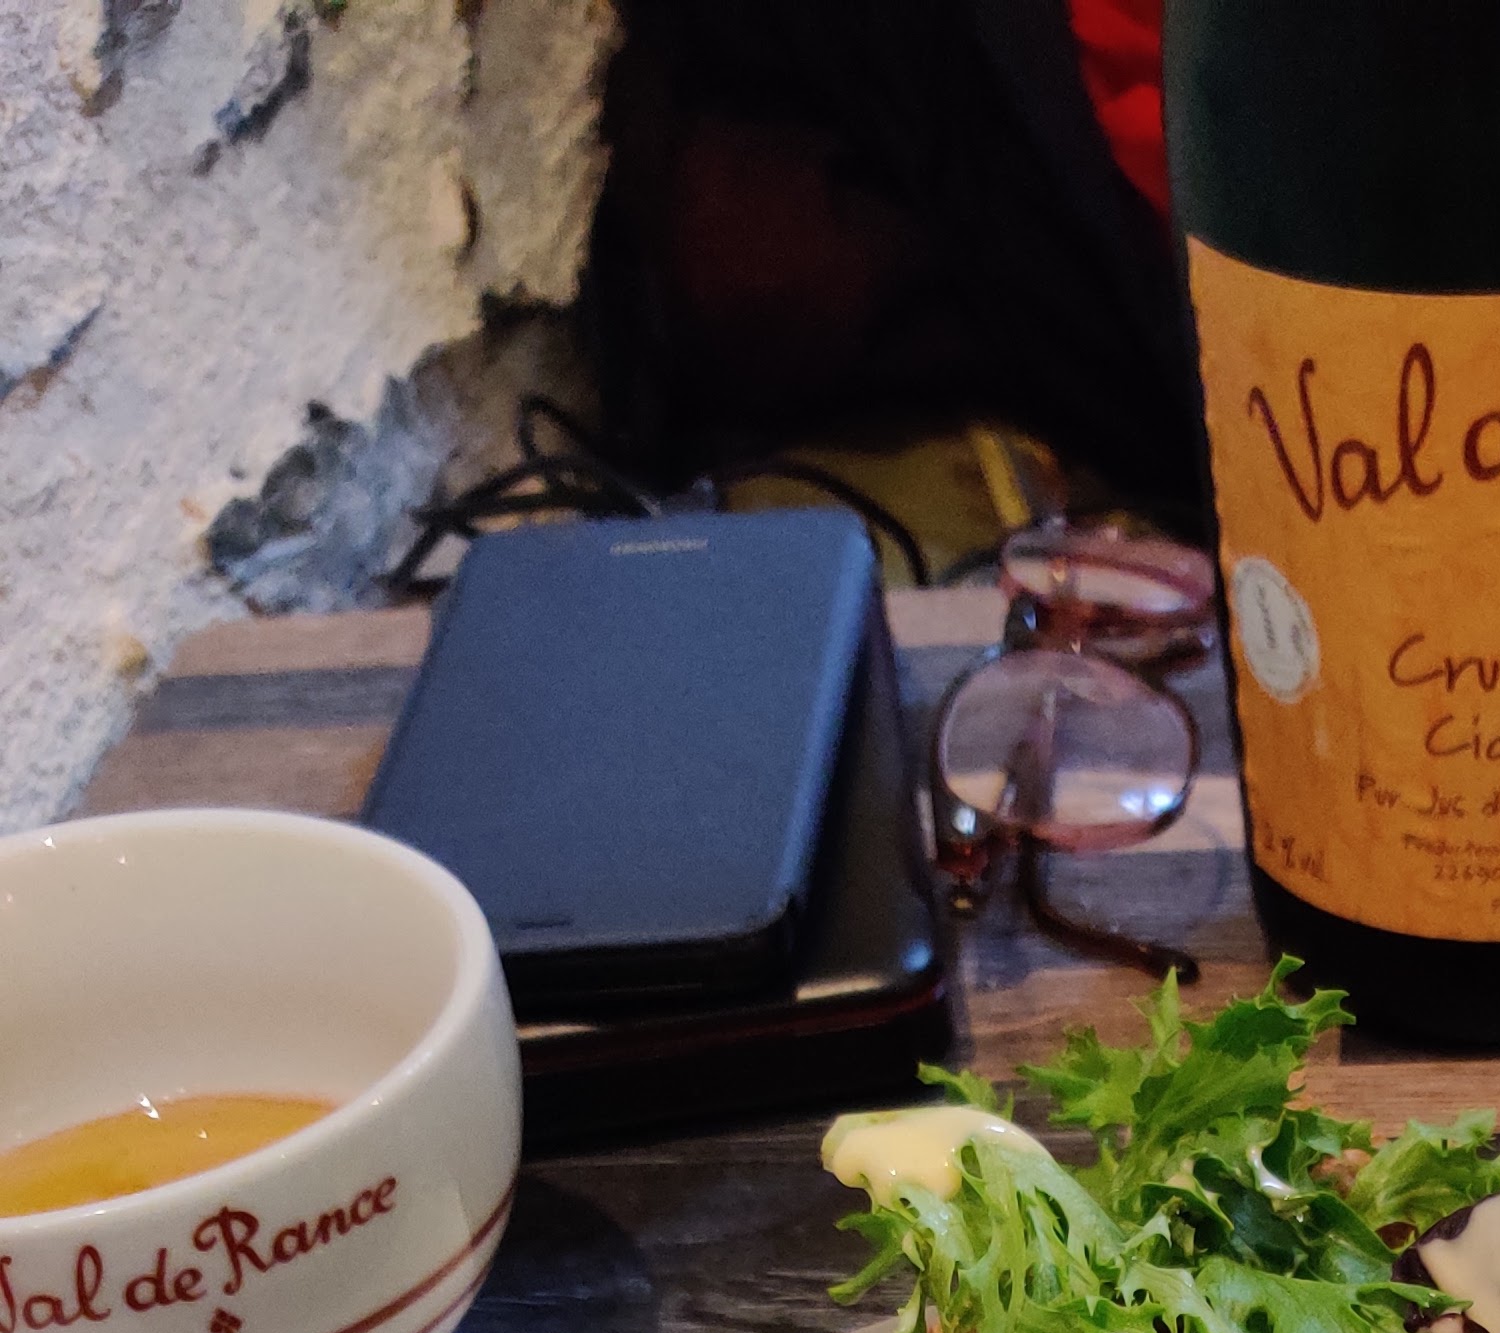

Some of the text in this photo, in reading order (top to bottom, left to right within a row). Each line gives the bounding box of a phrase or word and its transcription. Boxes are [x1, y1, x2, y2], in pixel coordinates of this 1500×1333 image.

[1249, 342, 1443, 523] Val
[1387, 633, 1500, 694] Cru
[124, 1247, 206, 1311] de
[193, 1176, 397, 1295] Rance
